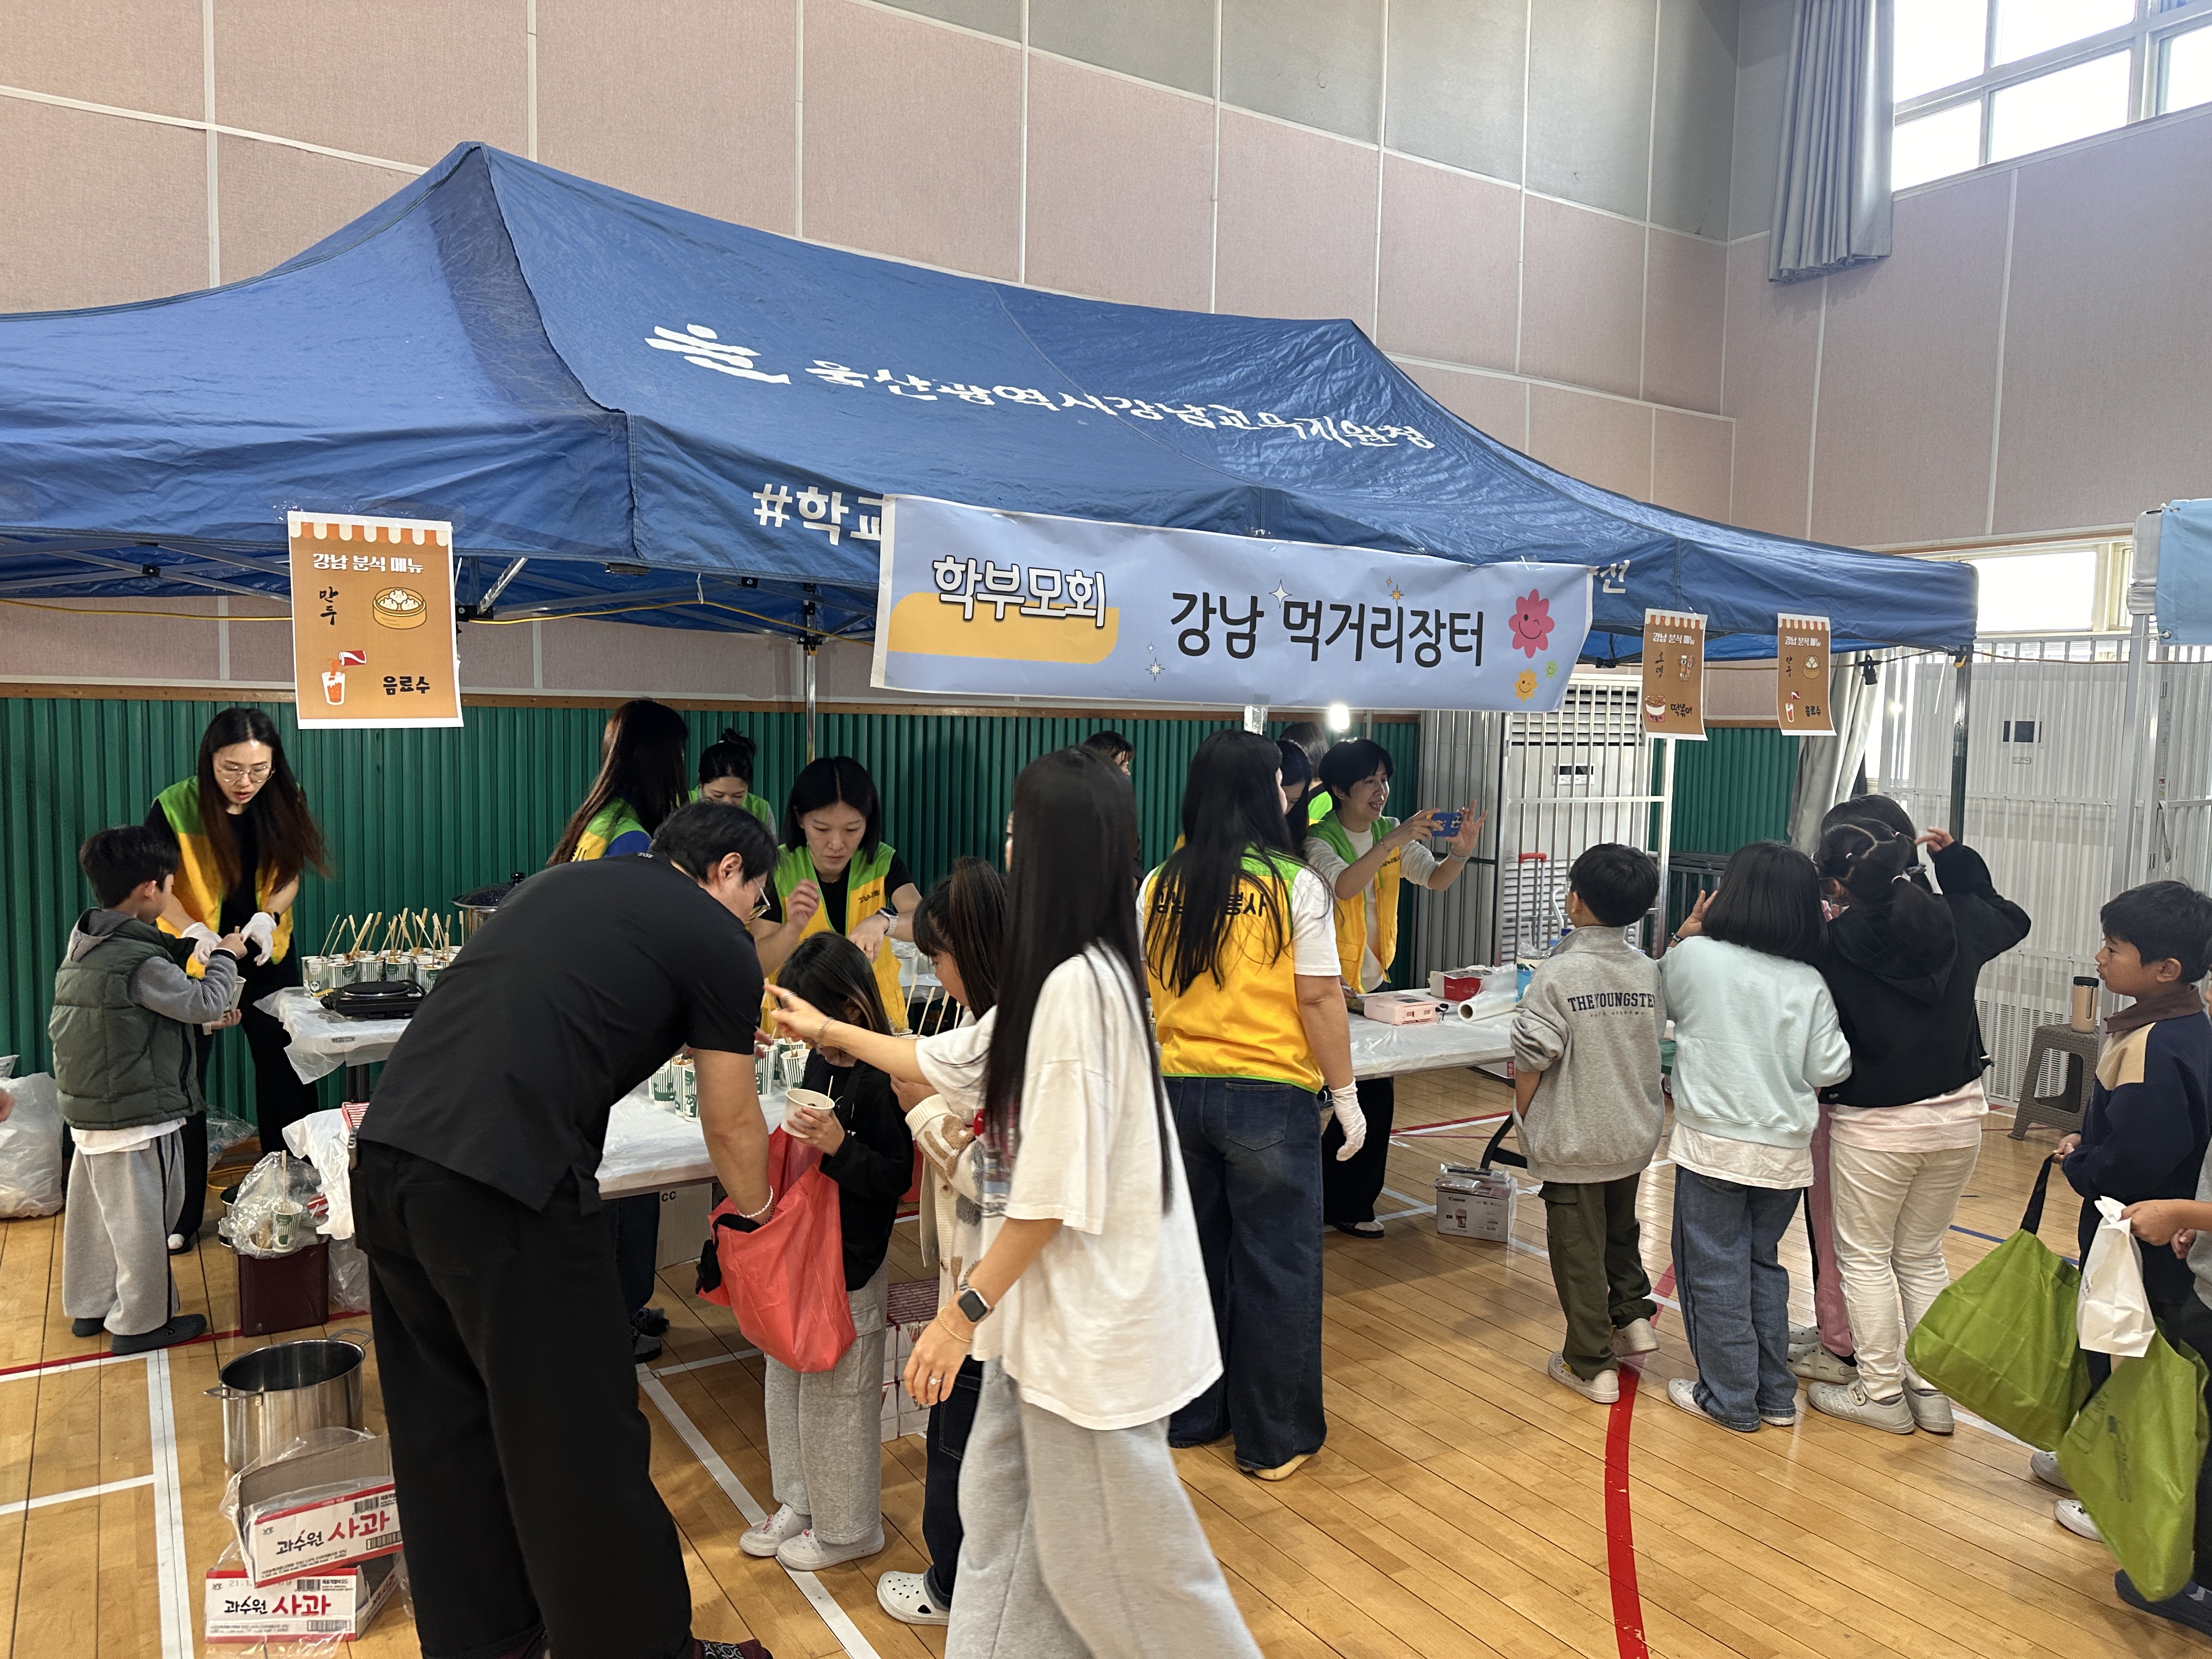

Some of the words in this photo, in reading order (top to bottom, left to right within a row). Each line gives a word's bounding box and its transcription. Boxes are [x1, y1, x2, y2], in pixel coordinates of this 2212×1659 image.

[313, 554, 348, 571] 강남
[353, 555, 386, 572] 분식
[391, 557, 424, 574] 메뉴
[932, 555, 1106, 629] 학부모회
[319, 586, 338, 626] 만두
[1171, 592, 1265, 659] 강남
[1283, 600, 1485, 668] 먹거리장터
[1653, 633, 1667, 643] 강남
[1669, 634, 1683, 644] 분식
[1684, 635, 1695, 645] 메뉴
[1785, 636, 1797, 646] 강남
[1798, 637, 1809, 646] 분식
[1810, 638, 1821, 647] 메뉴
[1655, 652, 1664, 678] 오뎅
[383, 676, 431, 696] 음료수
[1671, 703, 1693, 718] 떡볶이
[276, 1530, 324, 1555] 과수원
[328, 1510, 390, 1542] 사과
[224, 1595, 268, 1615] 과수원
[272, 1594, 331, 1616] 사과
